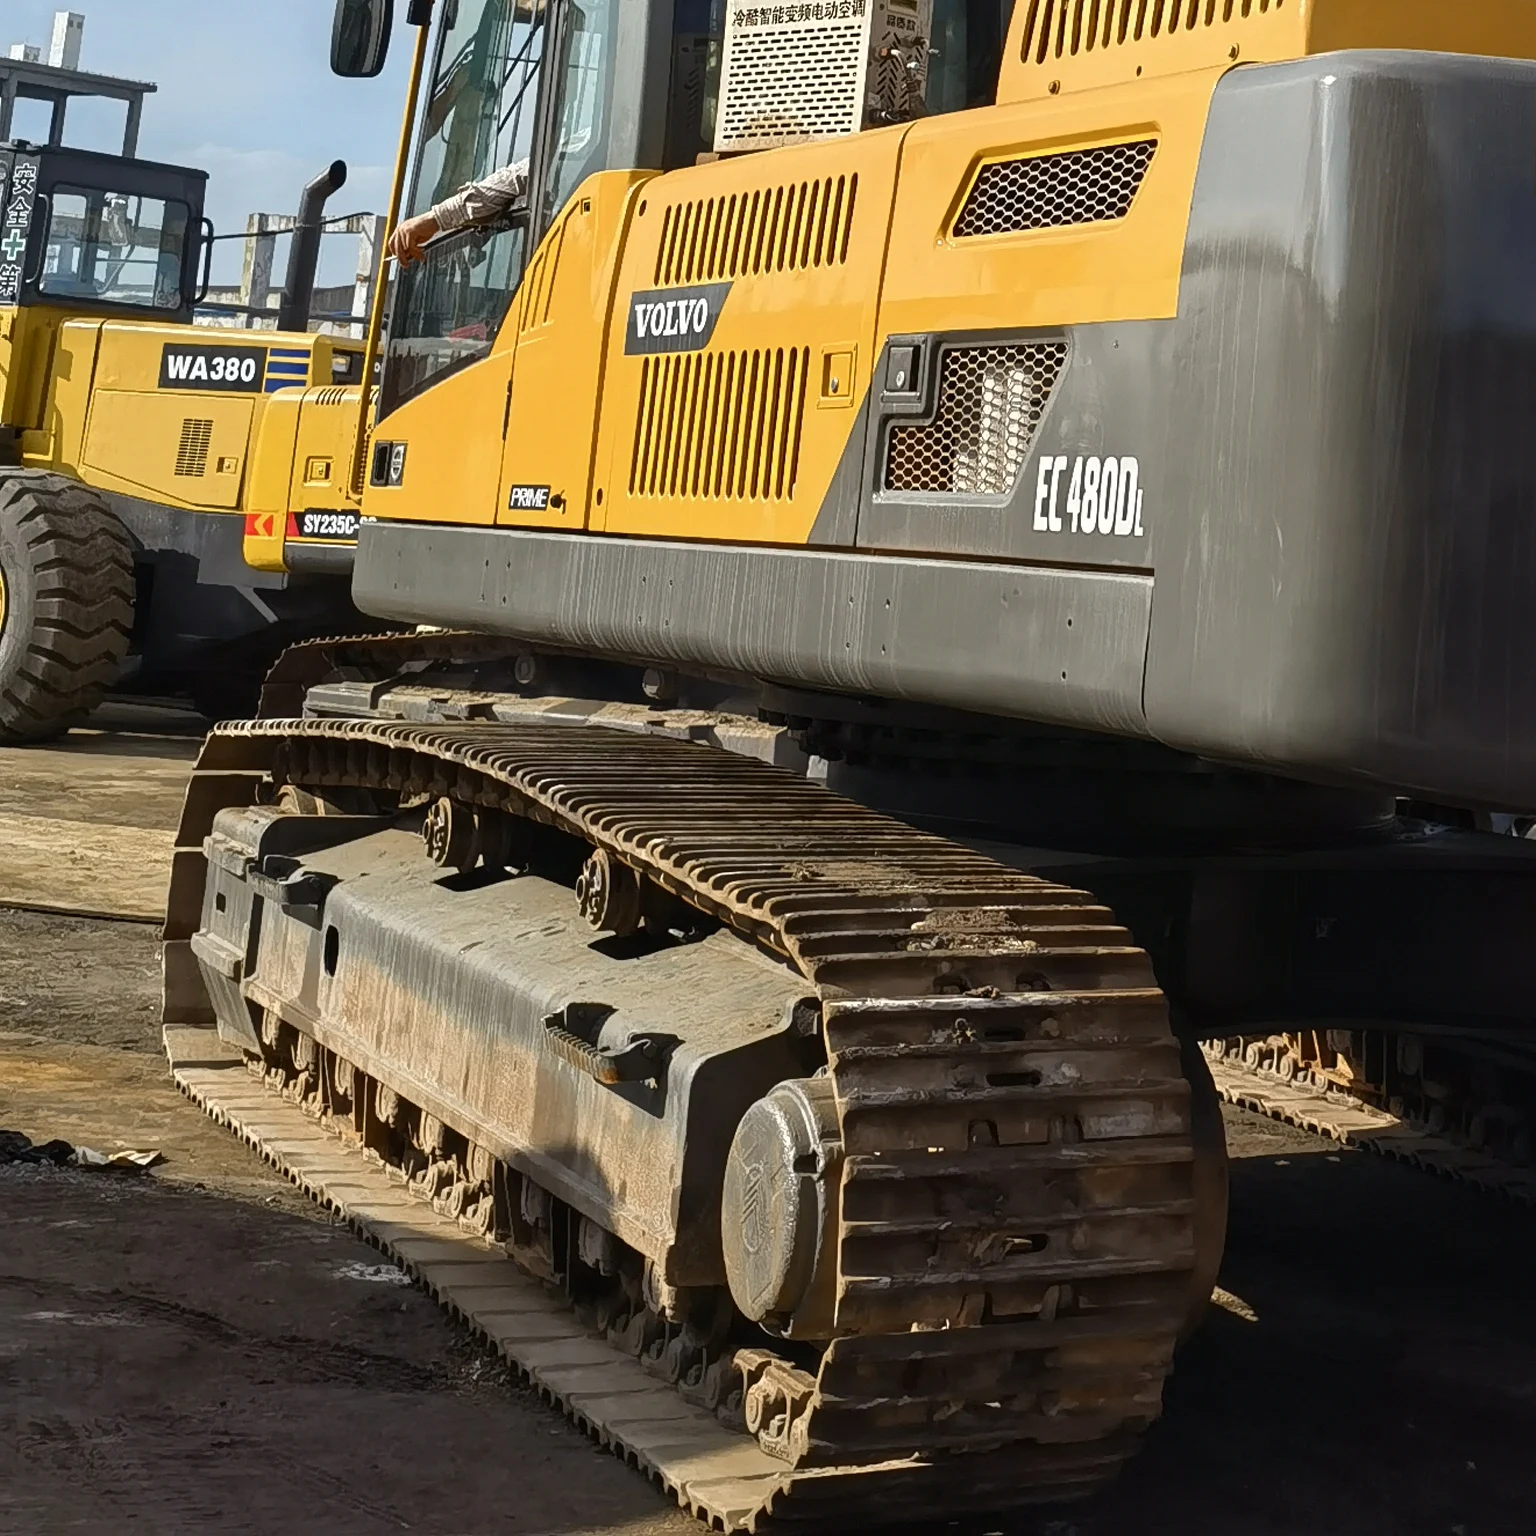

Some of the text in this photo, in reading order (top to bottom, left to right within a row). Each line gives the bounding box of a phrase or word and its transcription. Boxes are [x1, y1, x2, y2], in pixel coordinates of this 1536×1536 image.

[732, 0, 867, 27] 冷酷智能变频电动空调
[635, 298, 709, 338] VOLVO
[167, 355, 256, 382] WA380
[511, 487, 549, 508] PRIME
[304, 514, 378, 535] SY235C-
